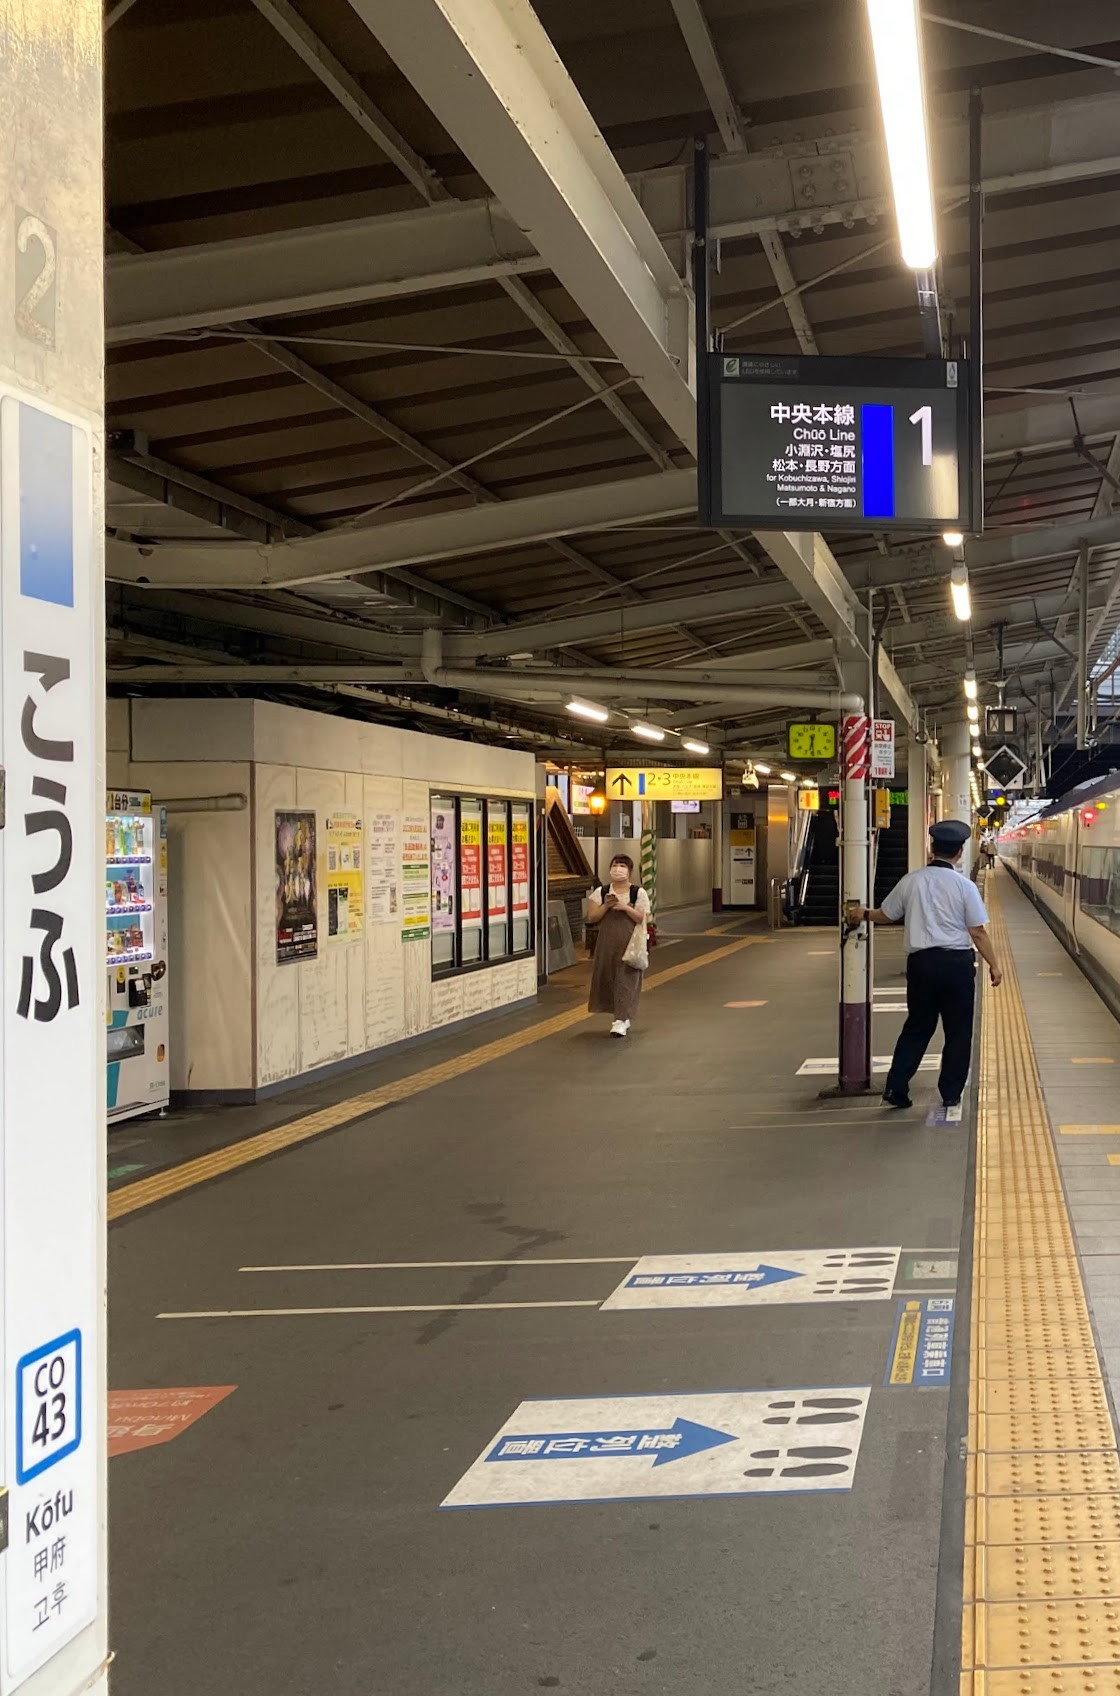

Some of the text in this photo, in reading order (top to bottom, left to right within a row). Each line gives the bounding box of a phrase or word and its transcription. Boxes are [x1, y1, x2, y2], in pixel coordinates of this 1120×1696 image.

[16, 214, 55, 348] 2
[770, 402, 855, 426] 中央本線
[793, 427, 856, 442] Chūō Line
[908, 405, 932, 466] 1
[785, 443, 856, 458] 小淵沢・塩尻
[772, 459, 856, 473] 松本・長野方面
[766, 474, 856, 485] for Kobuchizawa, Shiojiri
[777, 484, 818, 492] Matsumoto
[827, 485, 856, 494] Nagano
[647, 772, 671, 786] 2・3
[16, 650, 80, 1023] こうふ
[137, 1005, 163, 1021] acure
[34, 1356, 65, 1397] CO
[32, 1393, 67, 1448] 43
[498, 1433, 682, 1456] 整列位置
[26, 1489, 74, 1544] Kōfu
[34, 1536, 66, 1583] 甲府
[32, 1582, 68, 1633] 고후
